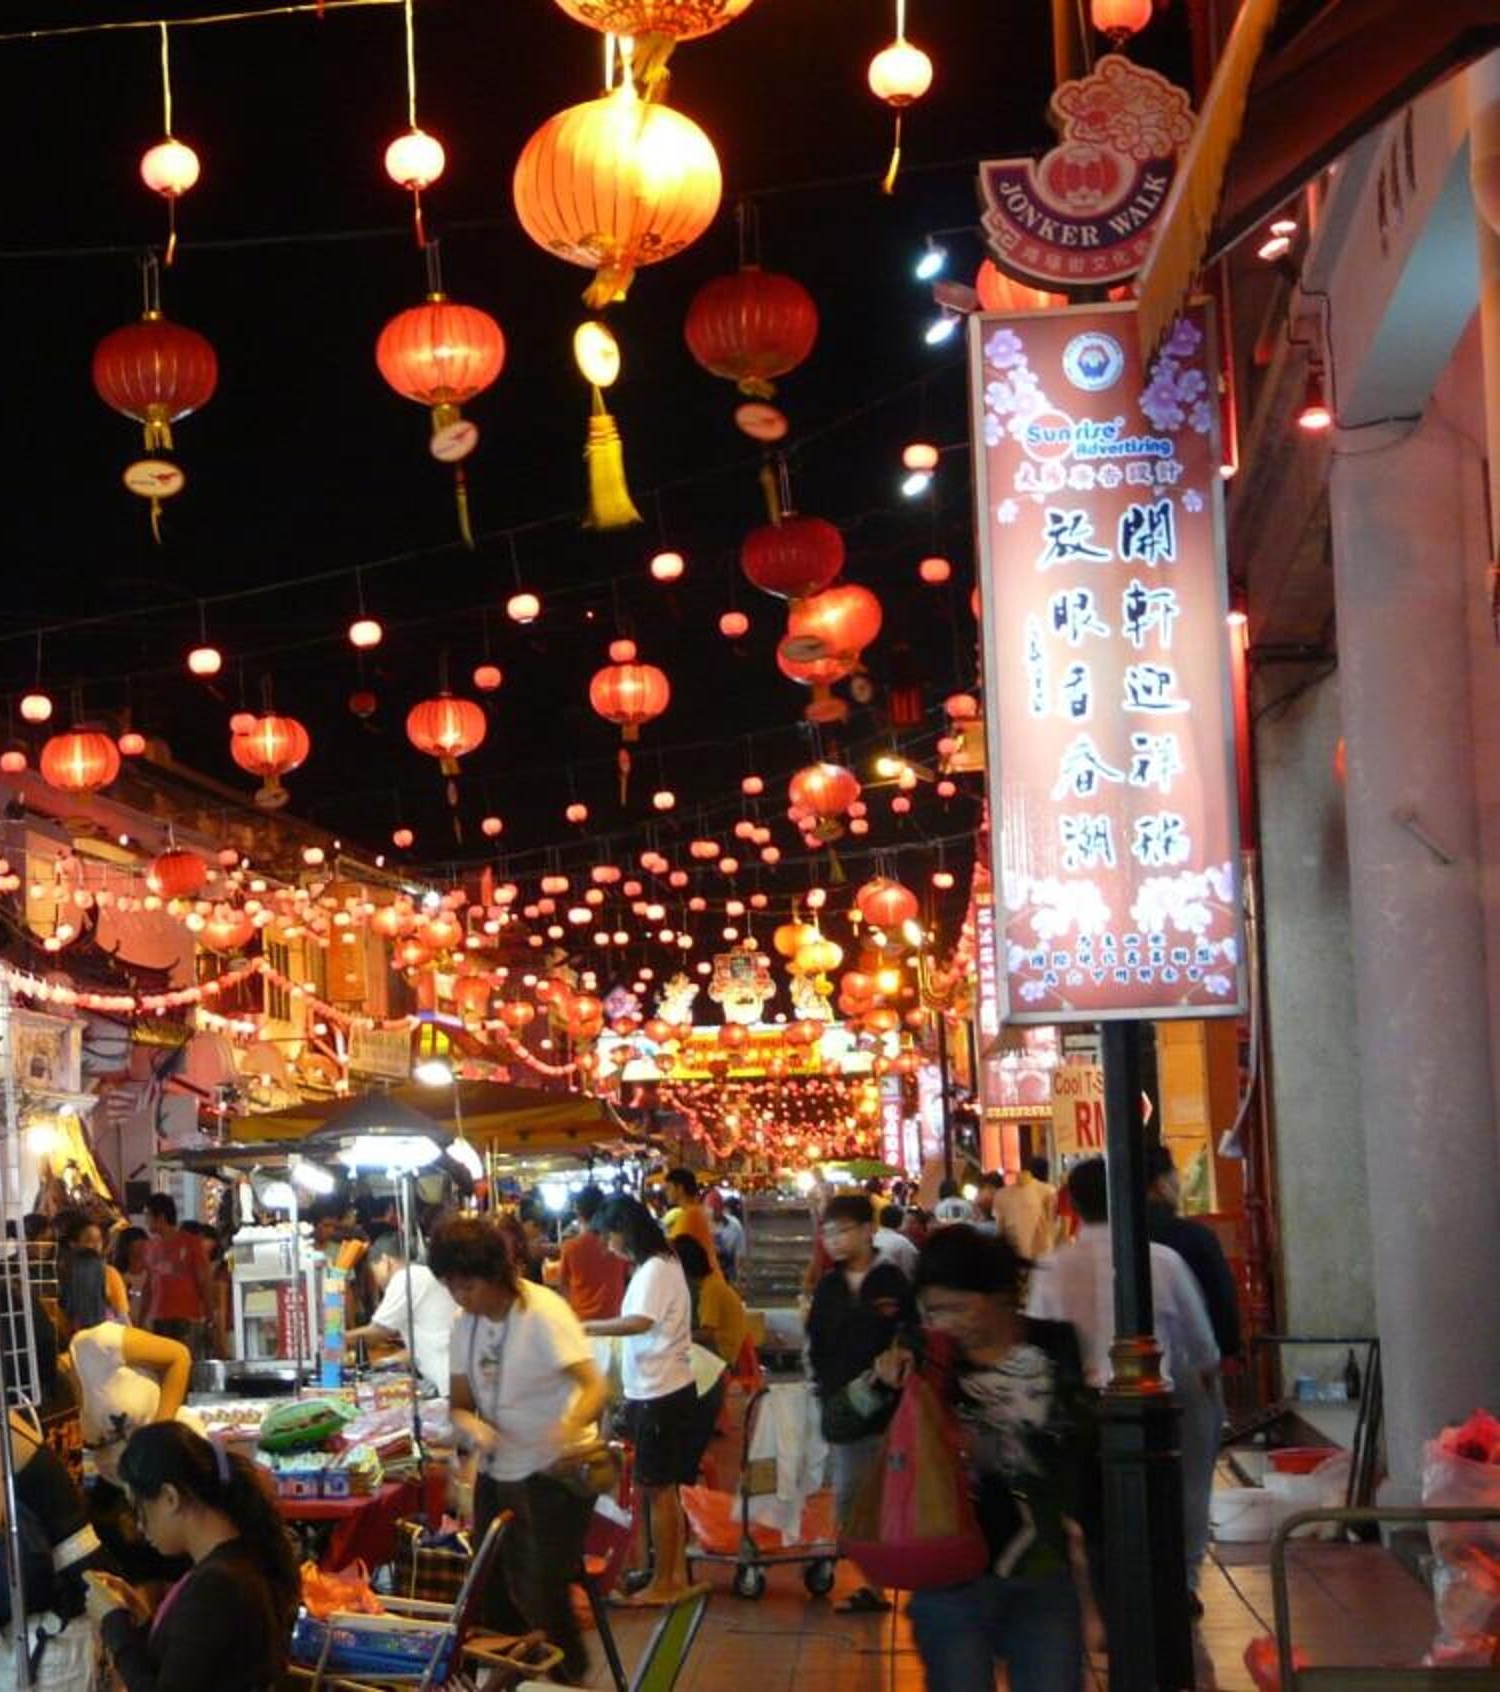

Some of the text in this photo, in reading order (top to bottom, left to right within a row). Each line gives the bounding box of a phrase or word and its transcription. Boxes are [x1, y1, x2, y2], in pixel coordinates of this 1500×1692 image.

[1000, 173, 1168, 246] JONKER WALK
[1026, 421, 1117, 445] Sunrise
[1053, 1070, 1083, 1097] Cool
